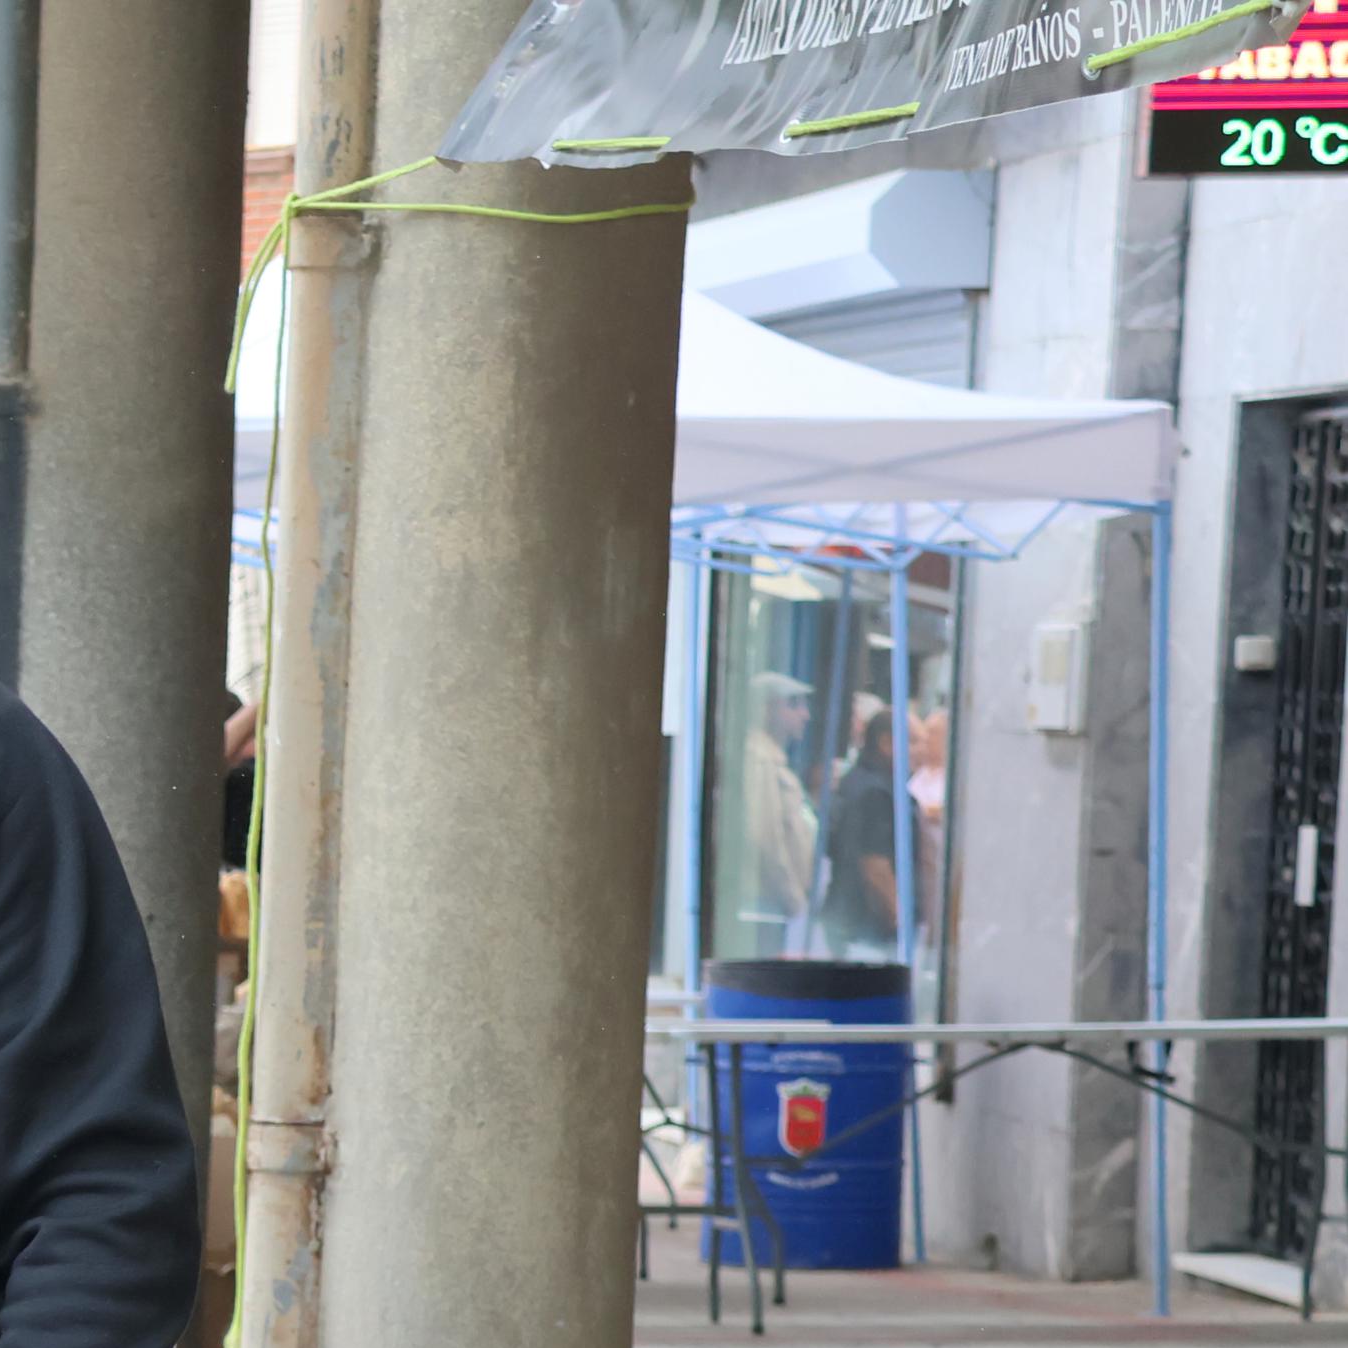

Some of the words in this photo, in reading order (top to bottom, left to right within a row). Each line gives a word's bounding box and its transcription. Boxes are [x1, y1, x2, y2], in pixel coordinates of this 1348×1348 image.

[988, 28, 1016, 78] DE
[1011, 3, 1081, 72] BAÑOS
[1220, 118, 1286, 166] 20
